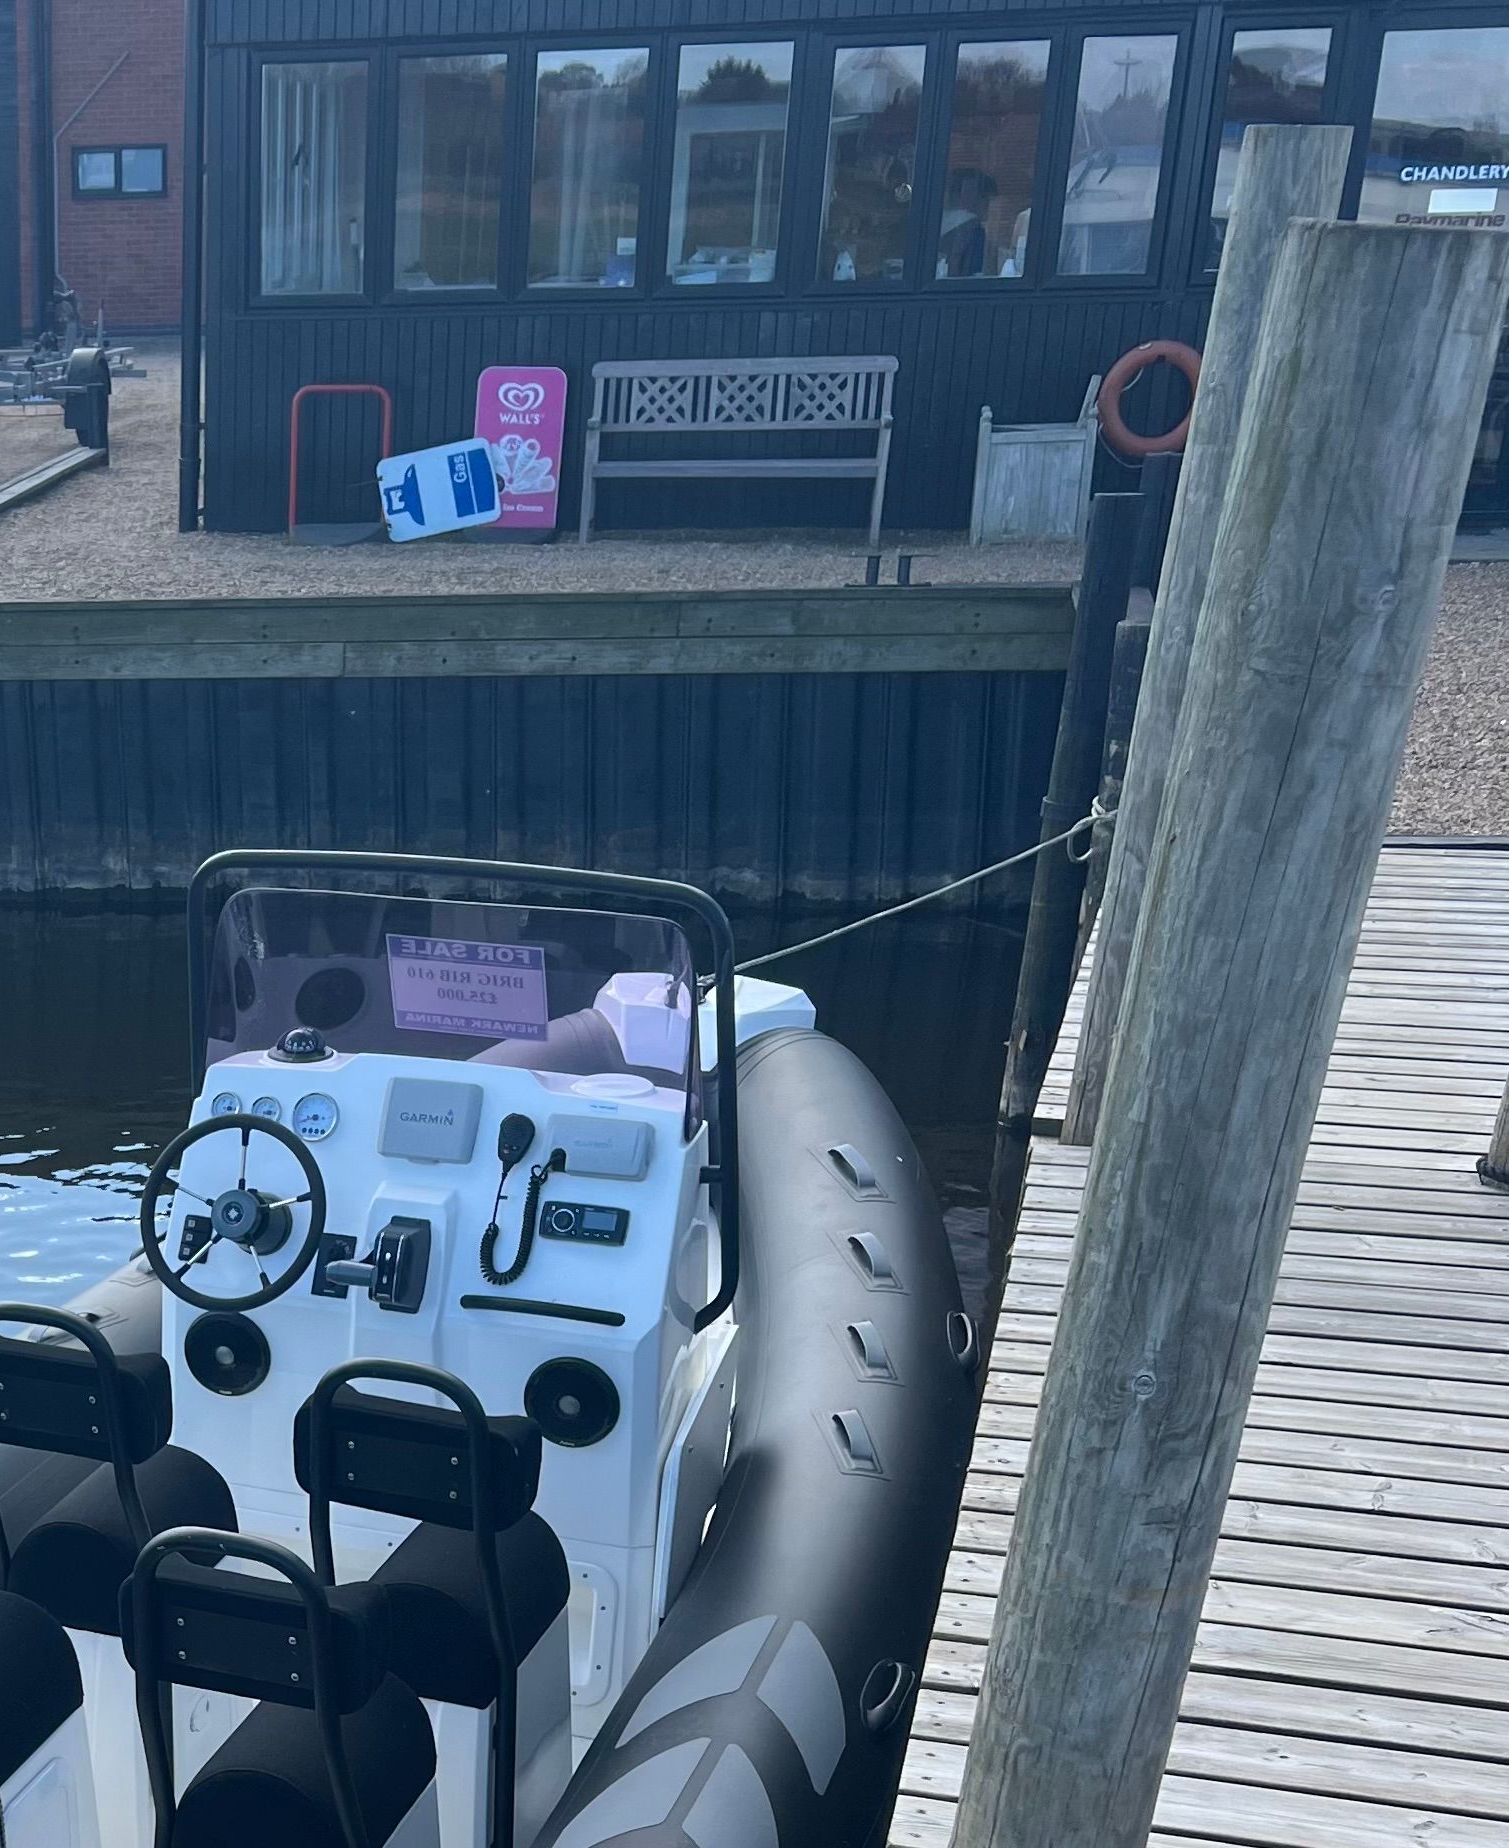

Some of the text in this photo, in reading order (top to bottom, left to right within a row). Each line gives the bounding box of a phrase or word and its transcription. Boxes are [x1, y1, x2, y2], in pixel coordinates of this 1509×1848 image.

[1400, 164, 1509, 182] CHANDLERY
[499, 413, 541, 425] WALL'S
[453, 455, 468, 483] Gas
[399, 1111, 454, 1126] GARMIN
